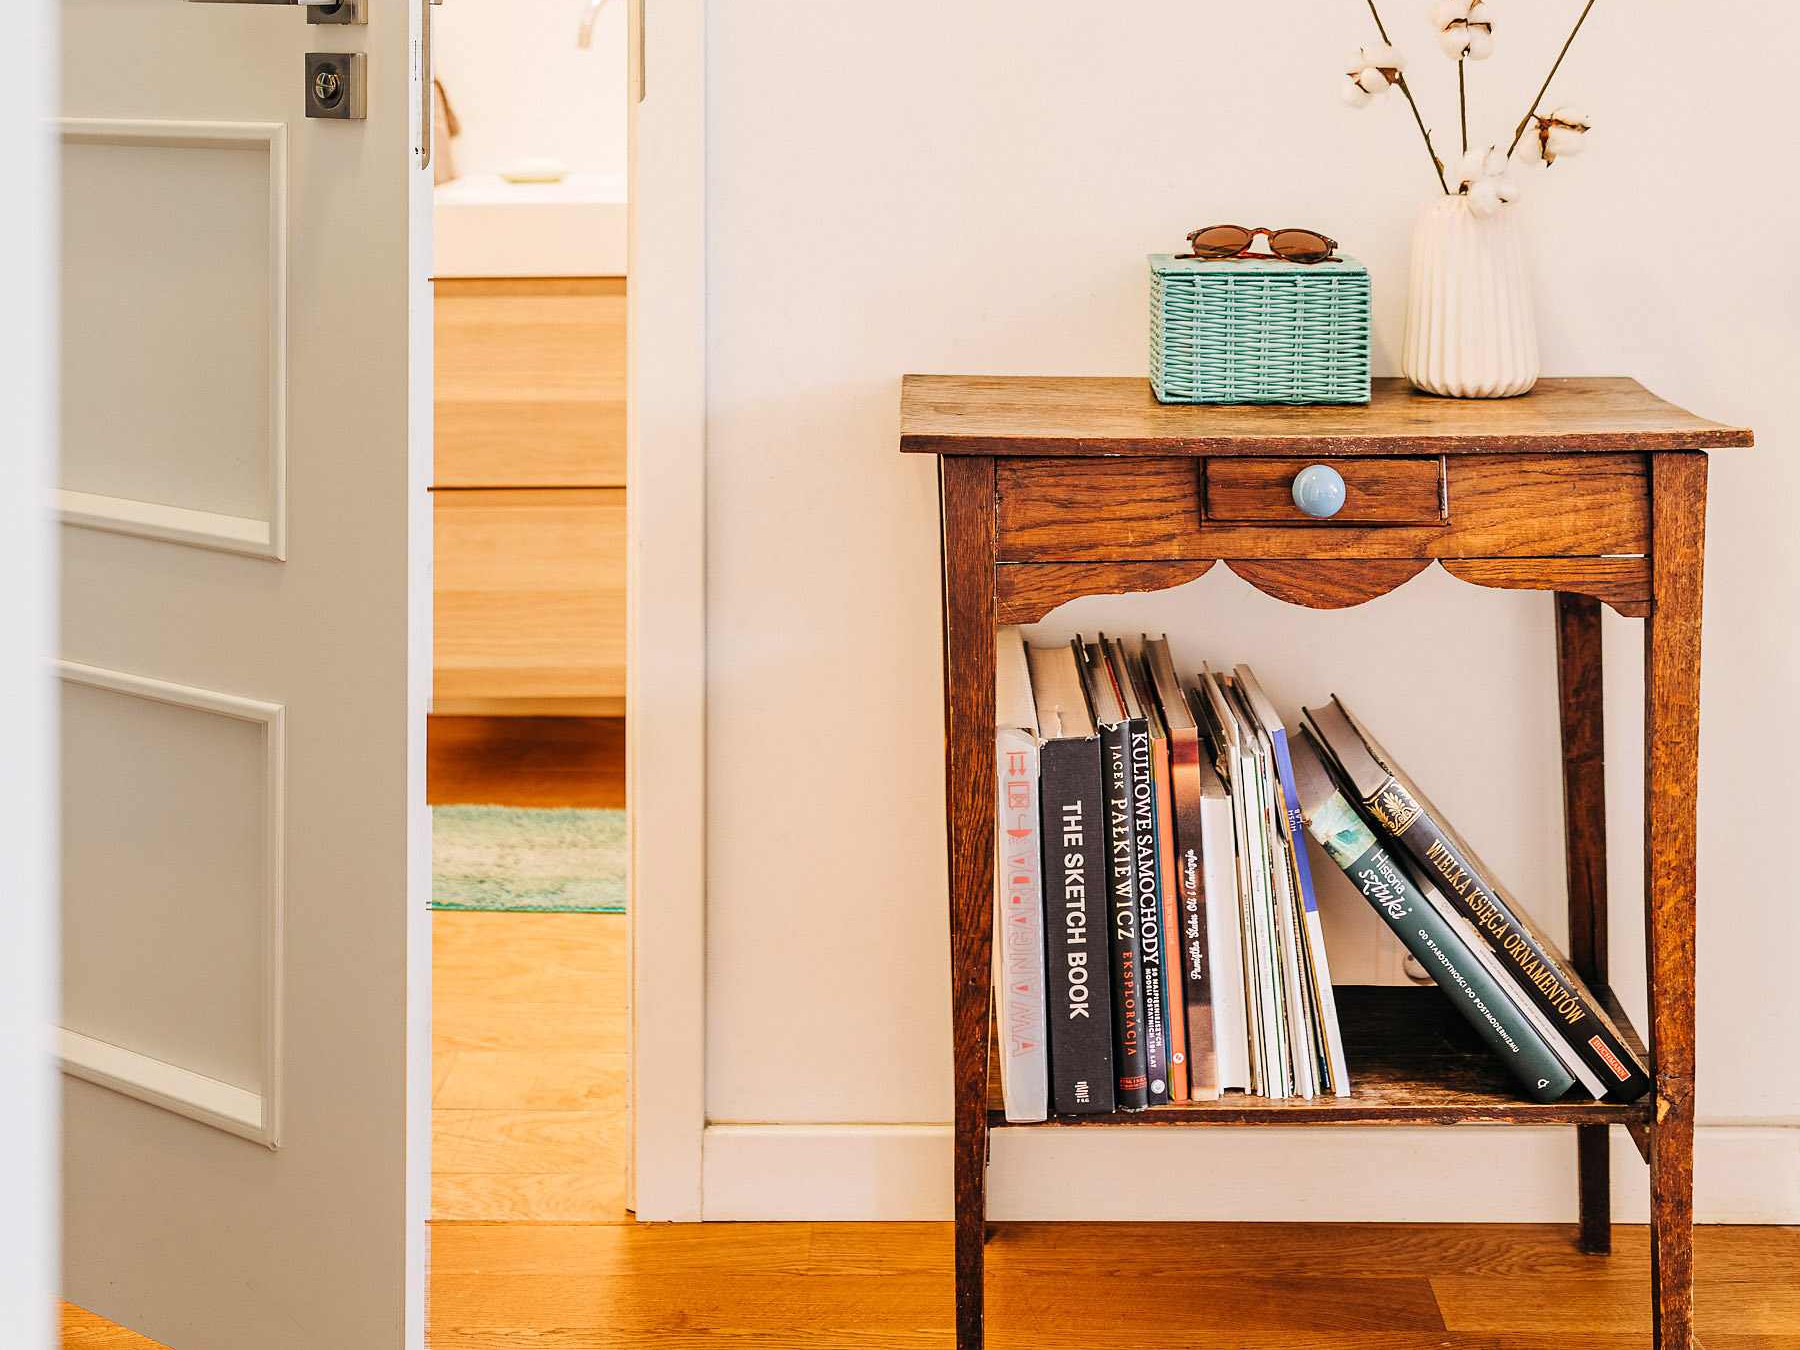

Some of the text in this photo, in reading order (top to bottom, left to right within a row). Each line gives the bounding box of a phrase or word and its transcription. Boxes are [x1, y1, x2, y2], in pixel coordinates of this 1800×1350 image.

[1109, 745, 1135, 940] JACEK PAŁKIEWICZ
[1131, 731, 1160, 965] KULTOWE SAMOCHODY
[1358, 868, 1413, 920] sztuki
[1370, 848, 1406, 895] Historia
[1062, 800, 1090, 1020] THE SKETCH BOOK
[1186, 897, 1198, 912] Oli
[1425, 838, 1473, 896] WIELKA
[1464, 886, 1510, 940] KSIĘGA
[1503, 933, 1586, 1025] ORNAMENTÓW
[1122, 951, 1138, 1057] EKSPLORACJA
[1144, 968, 1153, 998] MODELI
[1418, 929, 1520, 1053] OD STAROŻYTNOŚCI DO POSTMODERNIZMU
[1146, 998, 1155, 1039] OSTATNICH
[1149, 1055, 1157, 1069] LAT
[1592, 1039, 1628, 1079] BUCHMANN
